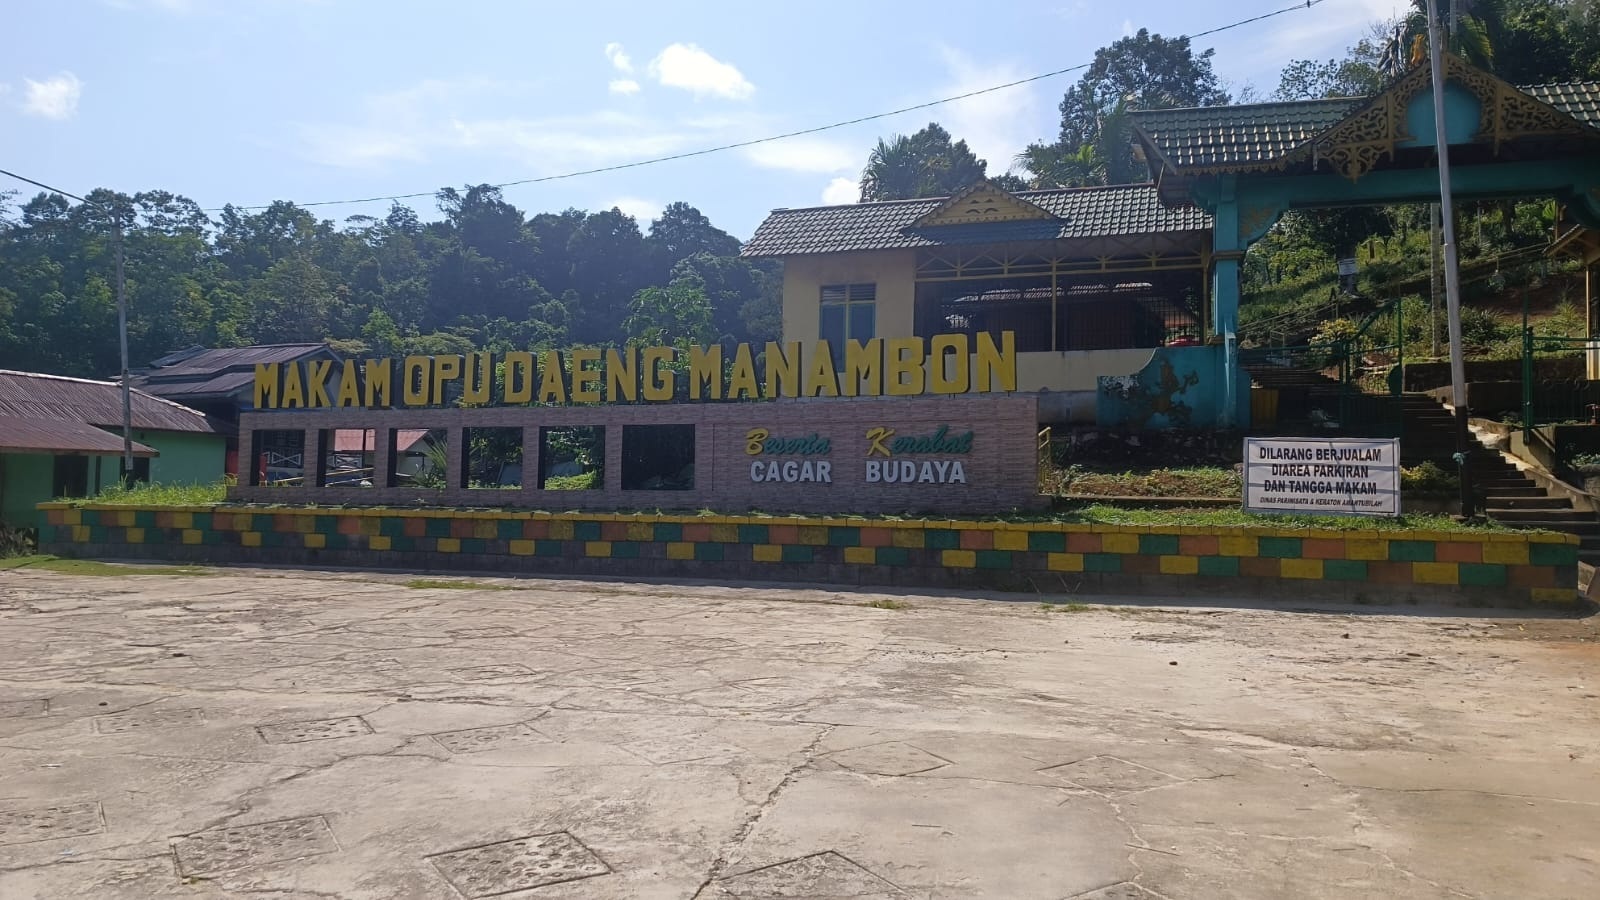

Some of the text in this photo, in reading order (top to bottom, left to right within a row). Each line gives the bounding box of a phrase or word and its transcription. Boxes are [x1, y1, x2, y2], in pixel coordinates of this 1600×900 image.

[254, 330, 1017, 408] MAKAM OPU DAENG MANAMBON
[745, 424, 974, 457] Beserta Kerabat
[1260, 447, 1313, 461] DILARANG
[750, 460, 967, 484] CAGAR BUDAYA
[1271, 464, 1369, 478] DIAREA PARKIRAN
[1264, 480, 1377, 495] DAN TANGGA MAKAM
